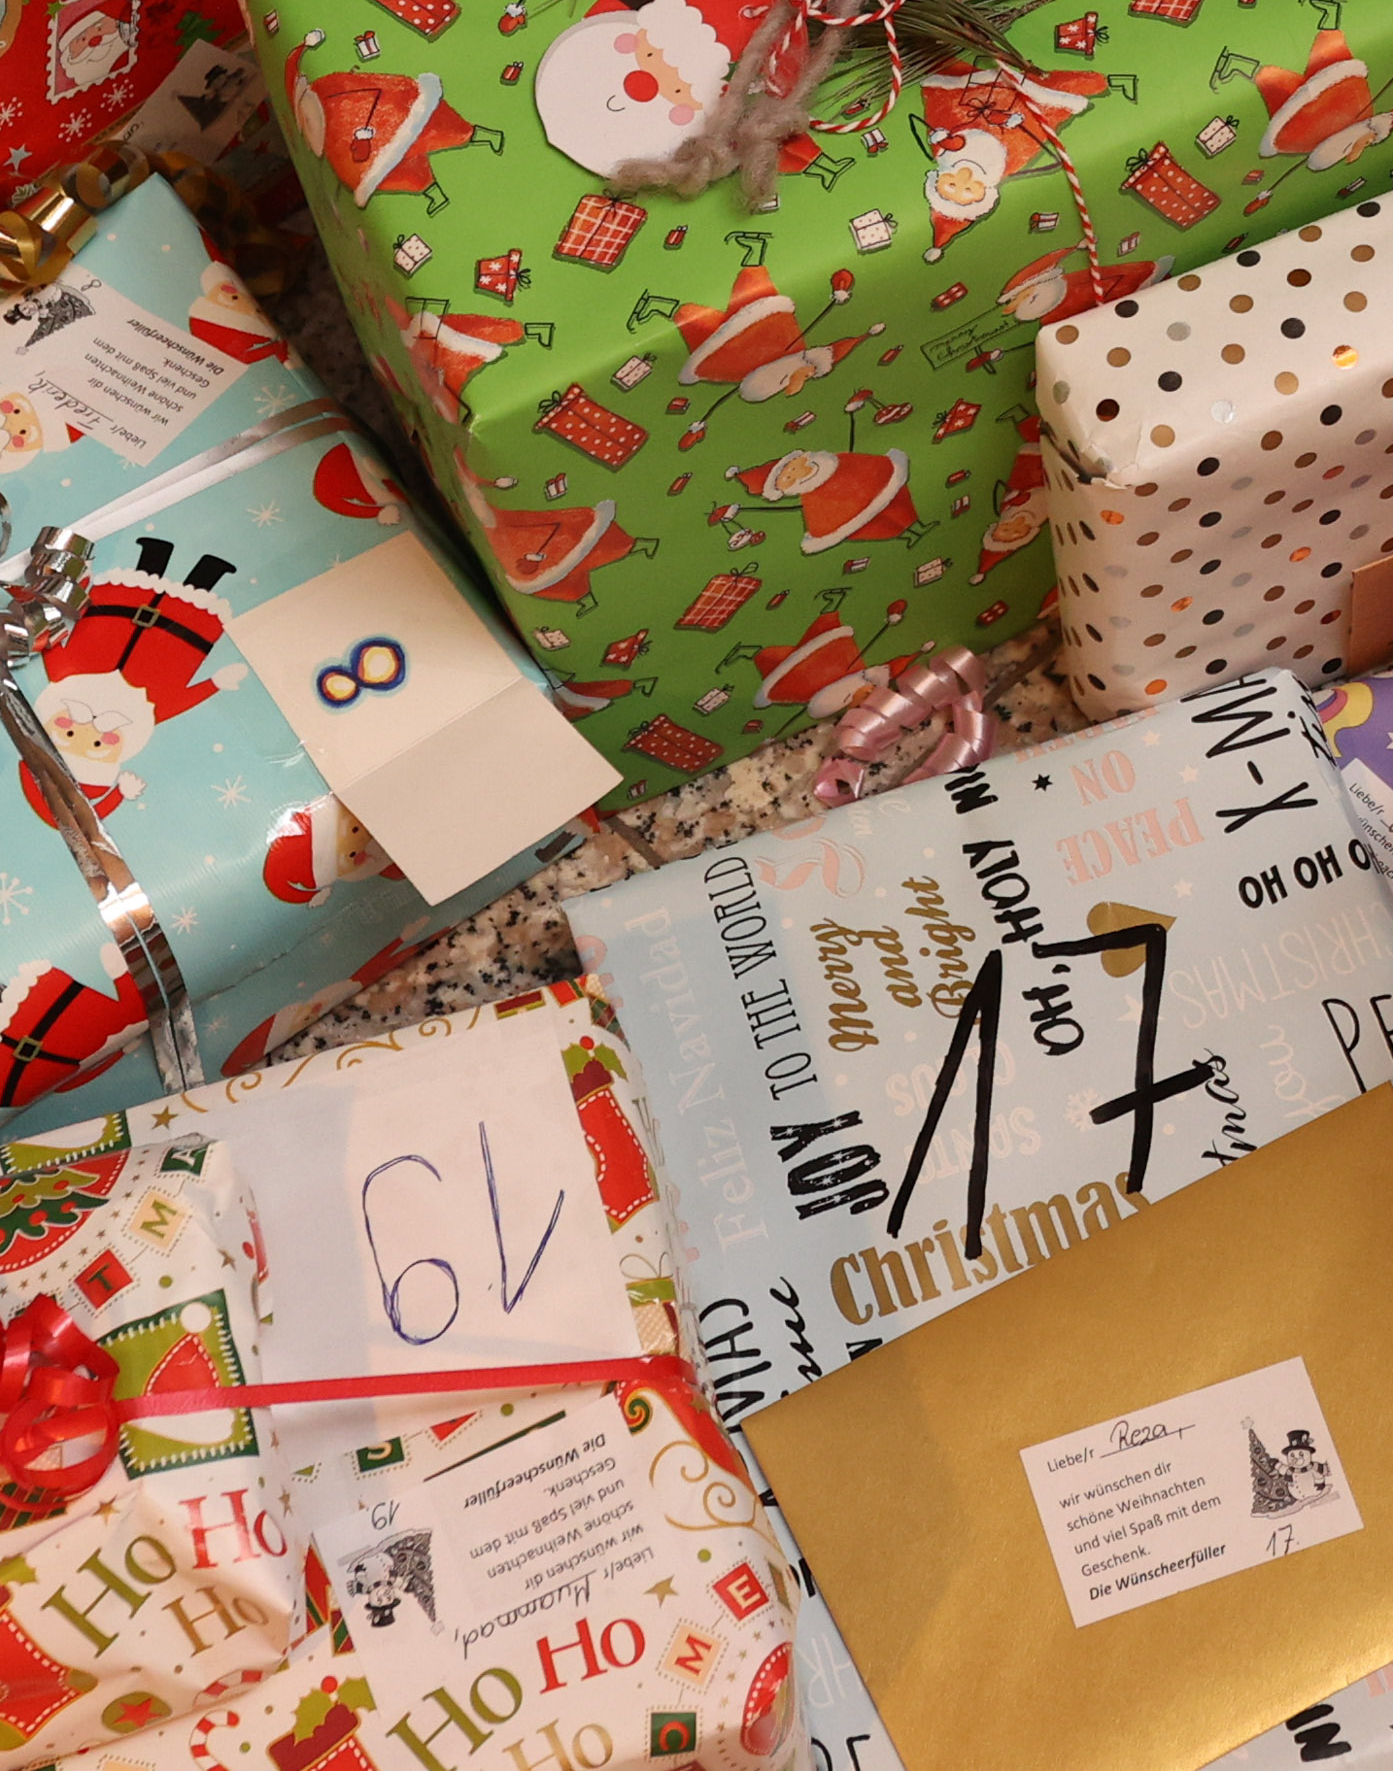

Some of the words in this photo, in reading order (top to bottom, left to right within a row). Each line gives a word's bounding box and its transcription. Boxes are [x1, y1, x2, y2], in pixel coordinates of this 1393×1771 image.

[126, 318, 206, 366] Wünscheerfüller
[84, 352, 148, 395] Weihnachten
[163, 358, 211, 388] Geschenk.
[102, 385, 152, 416] wünschen
[147, 390, 184, 413] schöne
[109, 424, 147, 449] Liebe/r
[316, 636, 407, 710] 8
[1067, 748, 1137, 808] ON
[1348, 782, 1385, 816] Liebe/r
[1056, 796, 1206, 887] PEACE
[962, 839, 1045, 945] HOLY
[703, 856, 778, 980] WORLD
[857, 925, 924, 1009] and
[741, 977, 802, 1050] THE
[764, 1051, 819, 1101] TO
[886, 923, 1215, 1261] 17
[769, 1109, 891, 1221] JOY
[361, 1120, 565, 1347] 19
[582, 1433, 606, 1453] Die
[1046, 1446, 1094, 1473] Liebe/r
[464, 1447, 580, 1509] Wünscheerfüller
[543, 1457, 617, 1497] Geschenk.
[597, 1478, 625, 1503] und
[1059, 1493, 1081, 1509] wir
[1083, 1470, 1152, 1501] wünschen
[1153, 1462, 1172, 1477] dir
[531, 1506, 568, 1534] Spaß
[569, 1494, 596, 1516] viel
[583, 1500, 634, 1533] schöne
[1066, 1508, 1115, 1532] schöne
[1115, 1476, 1206, 1514] Weihnachten
[1074, 1534, 1101, 1555] und
[1102, 1525, 1128, 1545] viel
[1128, 1513, 1164, 1536] Spaß
[1165, 1506, 1189, 1523] mit
[1191, 1496, 1222, 1514] dem
[469, 1538, 502, 1560] dem
[487, 1527, 583, 1579] Weihnachten
[504, 1525, 530, 1545] mit
[621, 1523, 644, 1543] wir
[545, 1536, 618, 1579] wünschen
[603, 1546, 654, 1581] Liebe/r
[1080, 1545, 1151, 1577] Geschenk.
[1089, 1583, 1112, 1601] Die
[1114, 1544, 1226, 1591] Wünscheerfüller
[524, 1573, 544, 1591] dir
